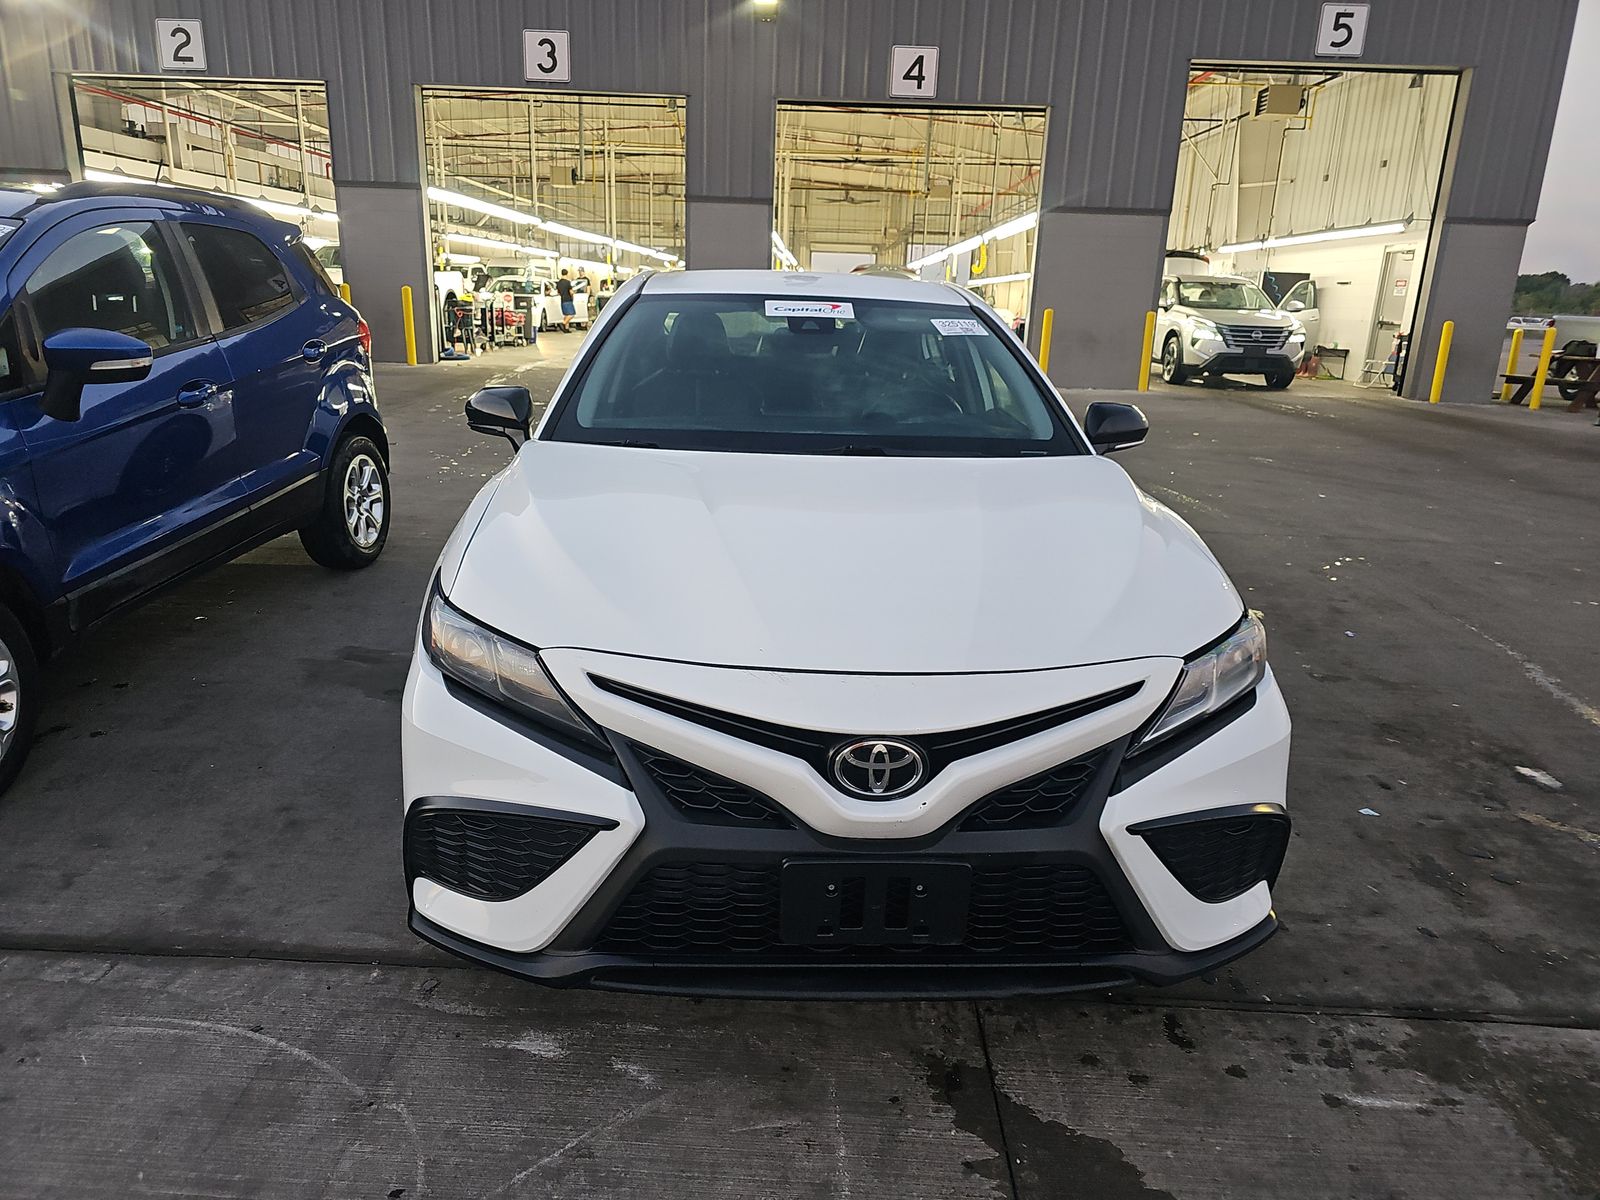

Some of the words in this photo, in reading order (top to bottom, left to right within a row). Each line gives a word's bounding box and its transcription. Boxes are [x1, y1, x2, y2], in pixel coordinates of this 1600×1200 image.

[170, 27, 194, 63] 2
[1329, 11, 1355, 48] 5
[536, 38, 558, 74] 3
[902, 54, 926, 90] 4
